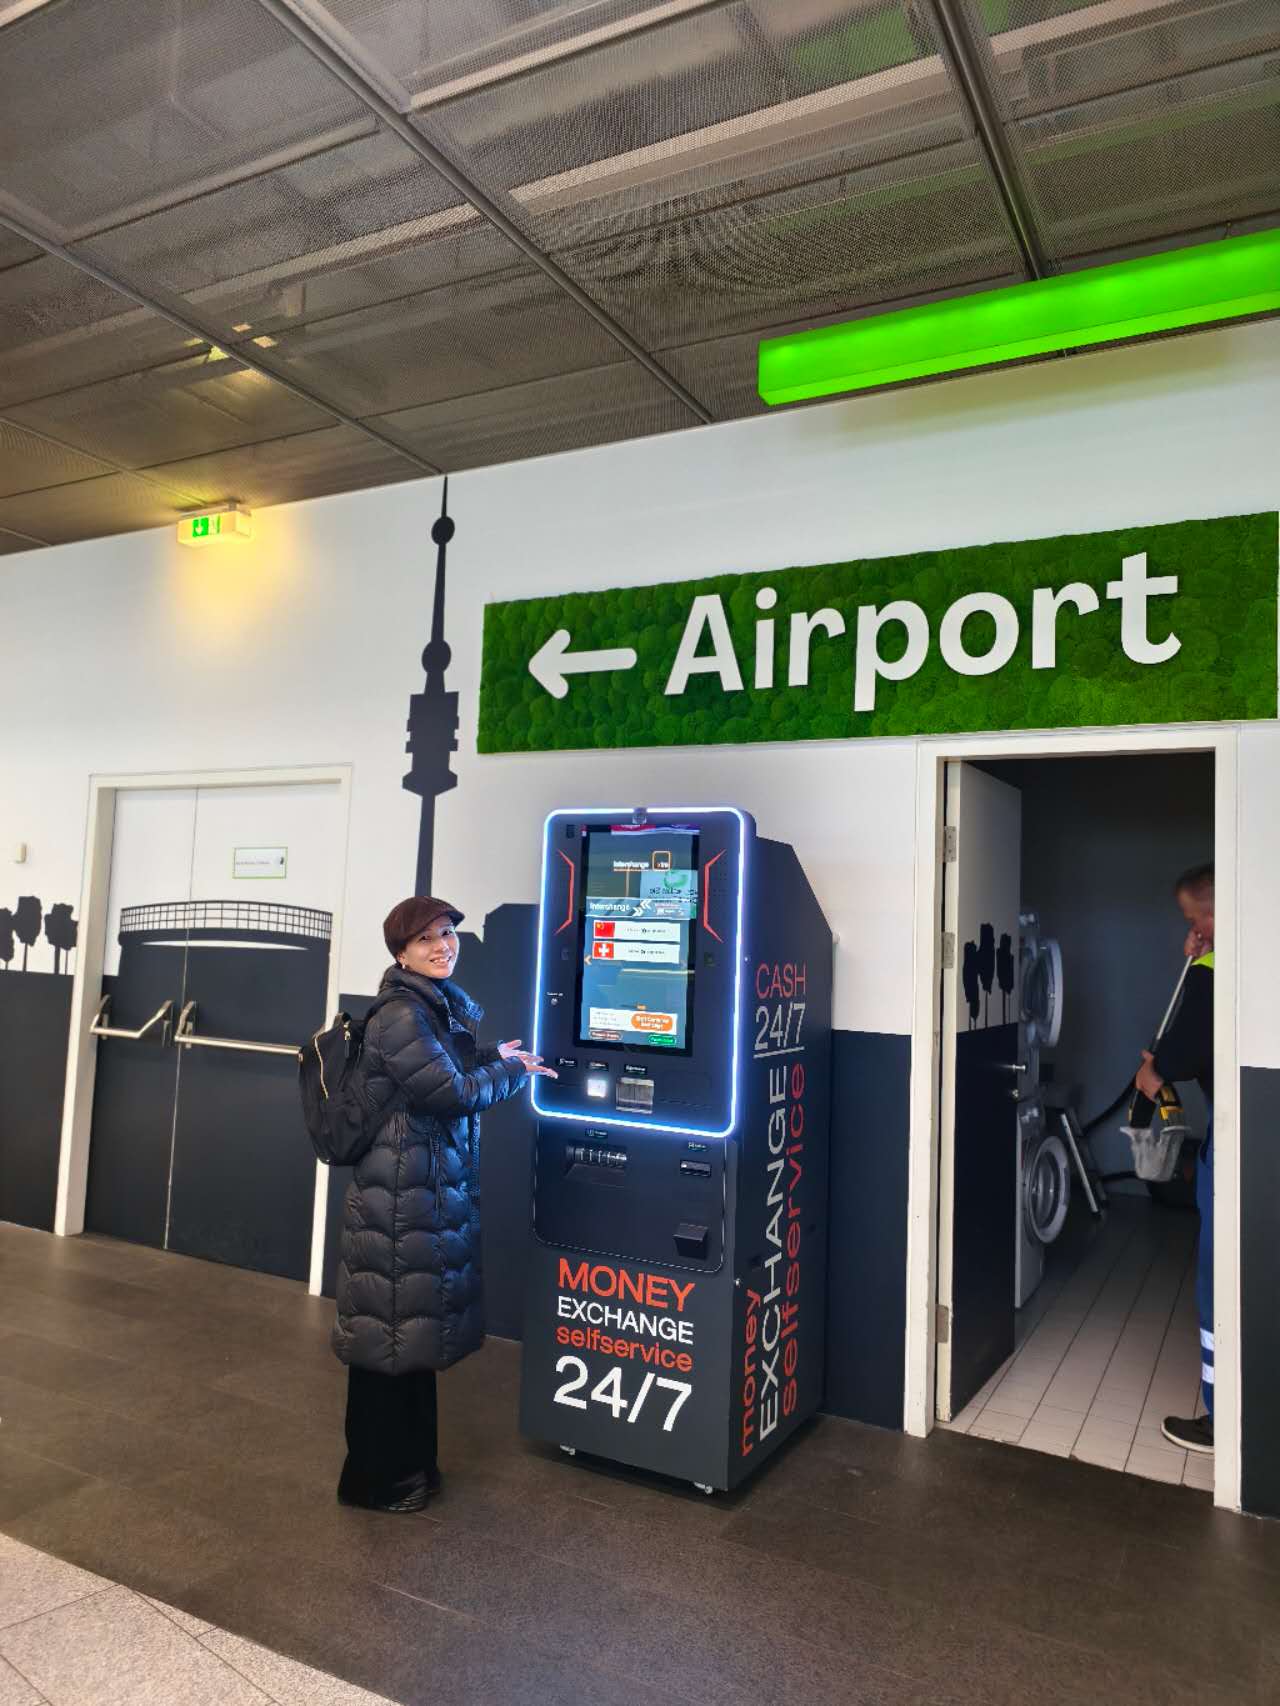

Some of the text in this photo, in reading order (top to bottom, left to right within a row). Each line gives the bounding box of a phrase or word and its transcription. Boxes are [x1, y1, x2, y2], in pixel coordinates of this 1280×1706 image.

[664, 551, 1182, 713] Airport
[756, 963, 806, 999] CASH
[754, 1001, 806, 1051] 24/7
[759, 1065, 788, 1442] EXCHANGE
[558, 1257, 696, 1312] MONEY
[557, 1295, 695, 1346] EXCHANGE
[556, 1325, 693, 1373] selfservice
[741, 1288, 761, 1457] money
[552, 1355, 693, 1432] 24/7
